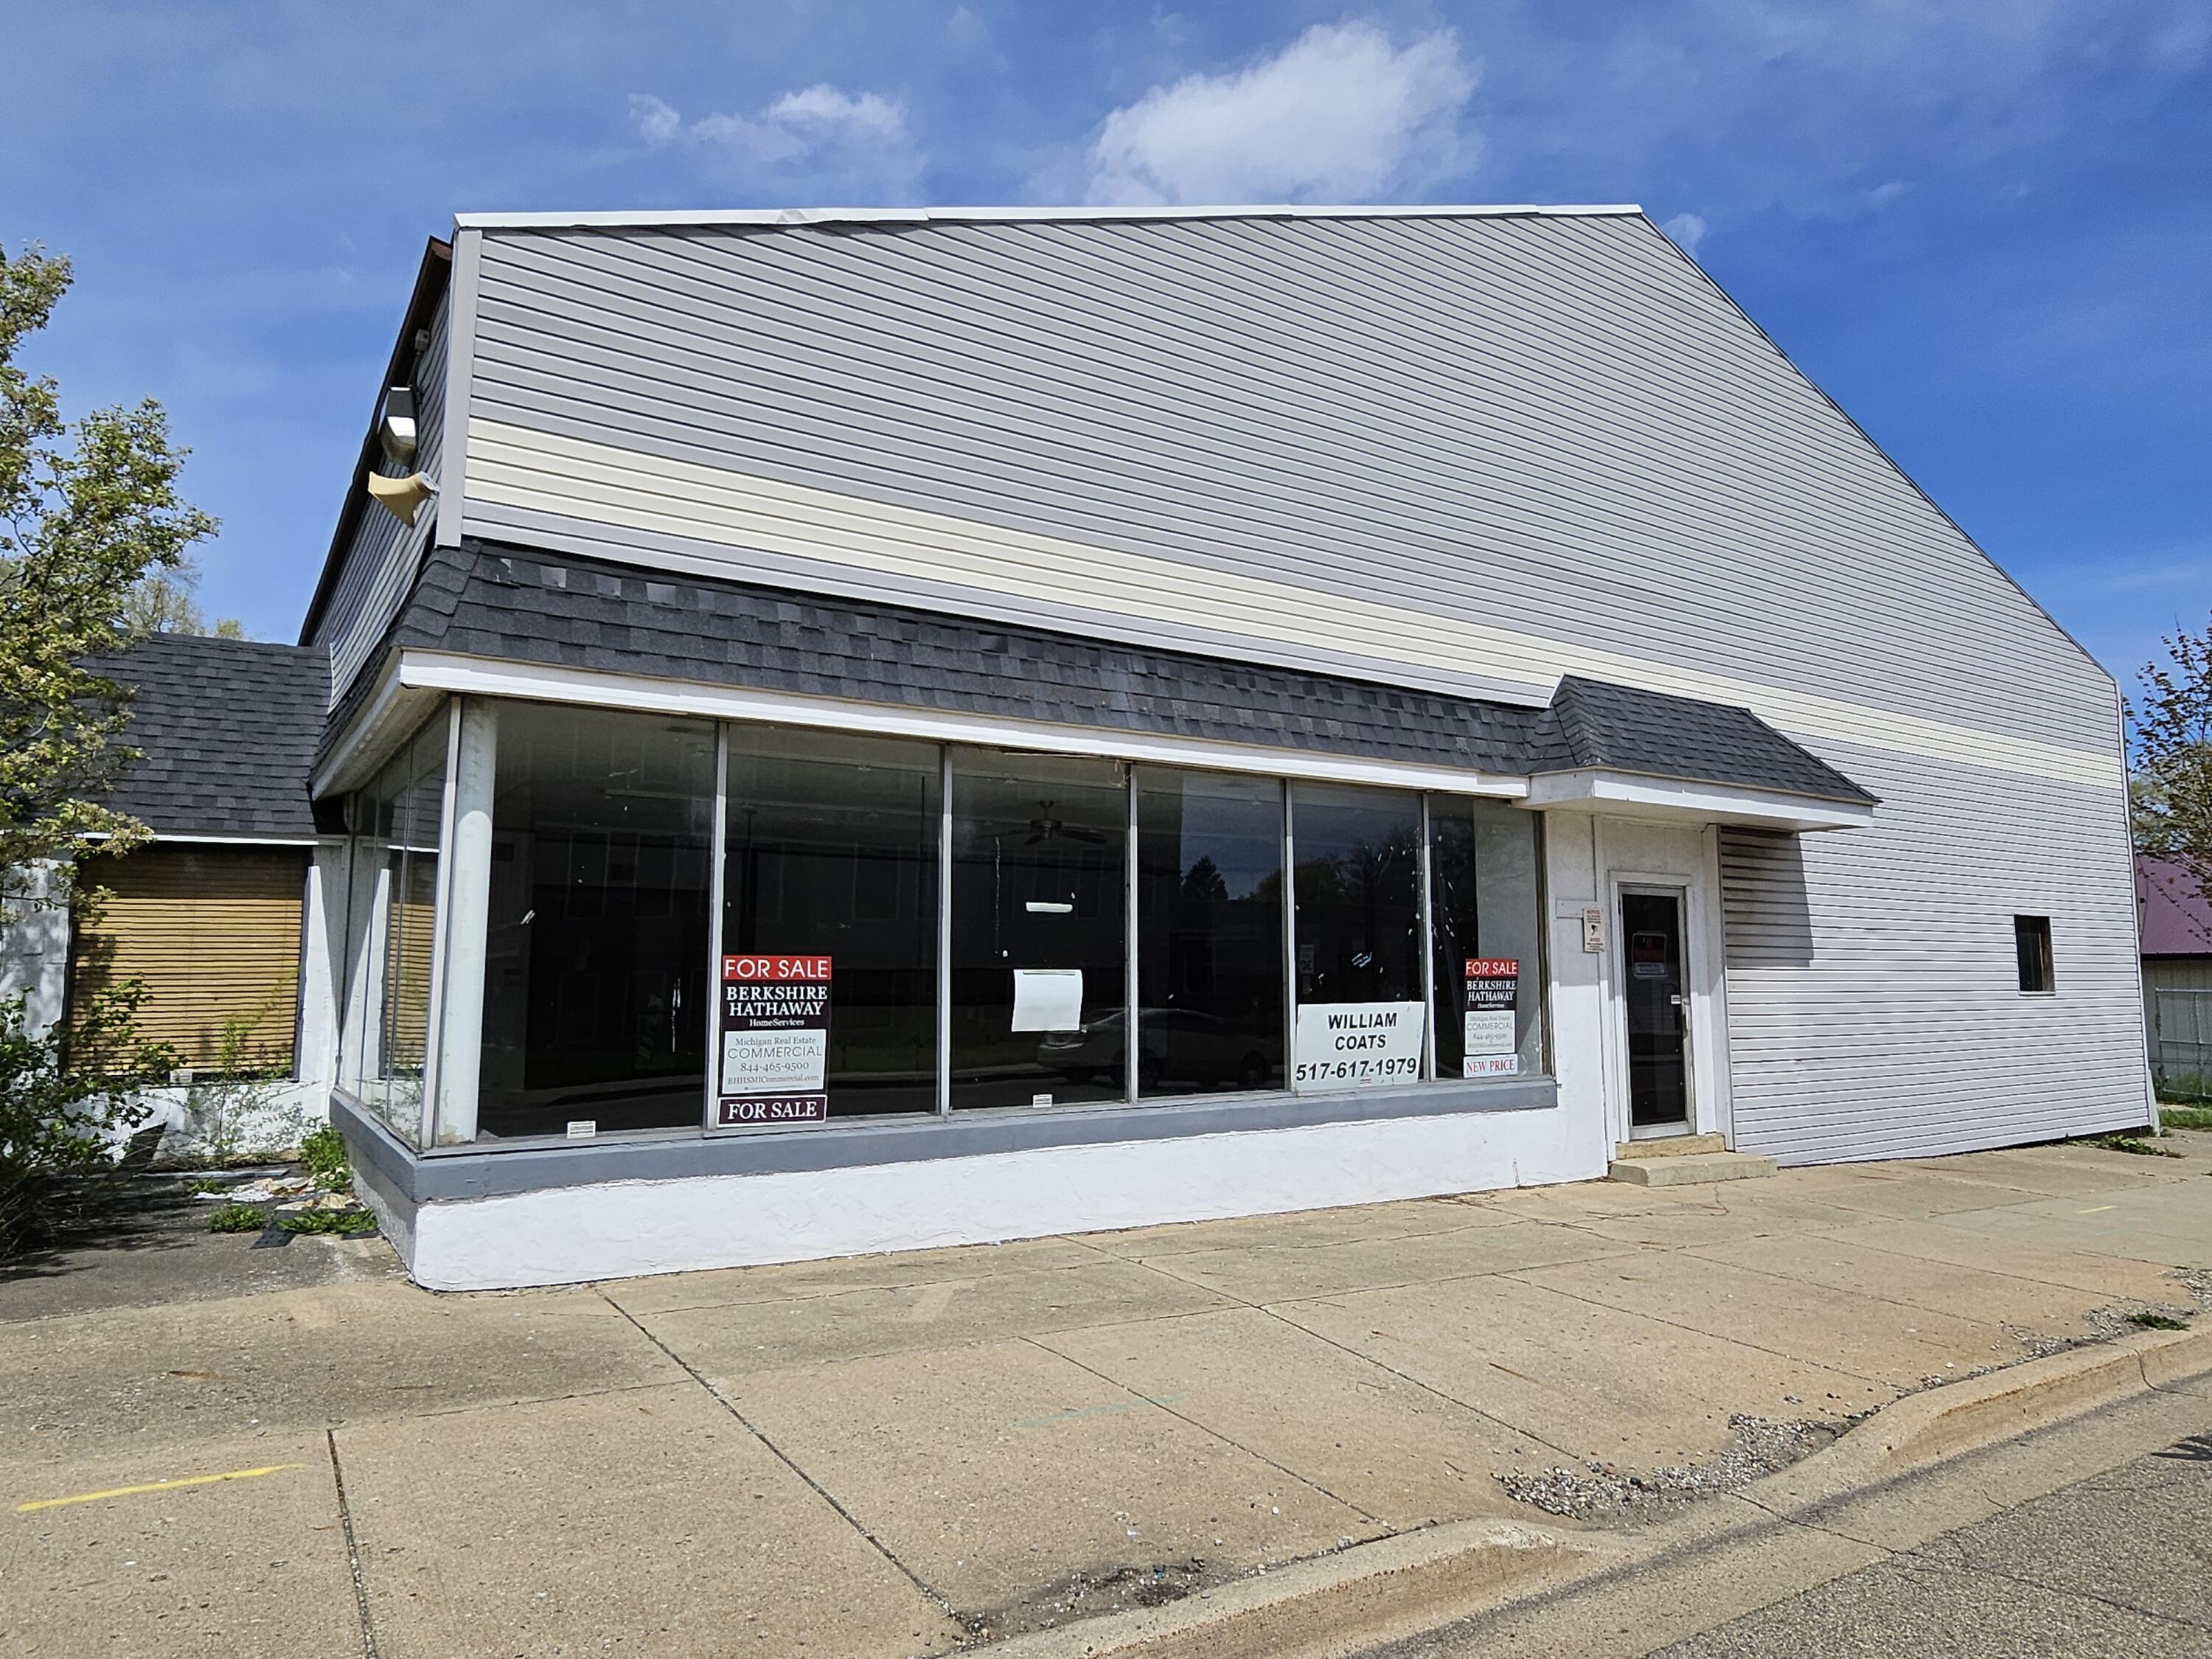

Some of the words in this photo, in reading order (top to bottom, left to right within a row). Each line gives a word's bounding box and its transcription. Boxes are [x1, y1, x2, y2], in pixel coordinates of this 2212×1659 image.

[725, 959, 770, 978] FOR
[778, 959, 828, 978] SALE
[1466, 961, 1489, 975] FOR
[1492, 961, 1517, 975] SALE
[1467, 980, 1516, 990] BERKSHIRE
[726, 986, 827, 1001] BERKSHIRE
[1468, 991, 1514, 1001] HATHAWAY
[728, 1001, 824, 1017] HATHAWAY
[749, 1018, 805, 1027] HomeServices
[1328, 1012, 1397, 1030] WILLIAM
[735, 1037, 772, 1047] Michigan
[774, 1036, 791, 1045] Real
[1335, 1034, 1387, 1051] COATS
[727, 1046, 822, 1060] COMMERCIAL
[740, 1062, 810, 1074] 844-465-9500
[1296, 1057, 1417, 1082] 517-617-1979
[1467, 1061, 1486, 1074] NEW
[1490, 1059, 1514, 1071] PRICE
[727, 1103, 767, 1119] FOR
[771, 1101, 817, 1118] SALE
